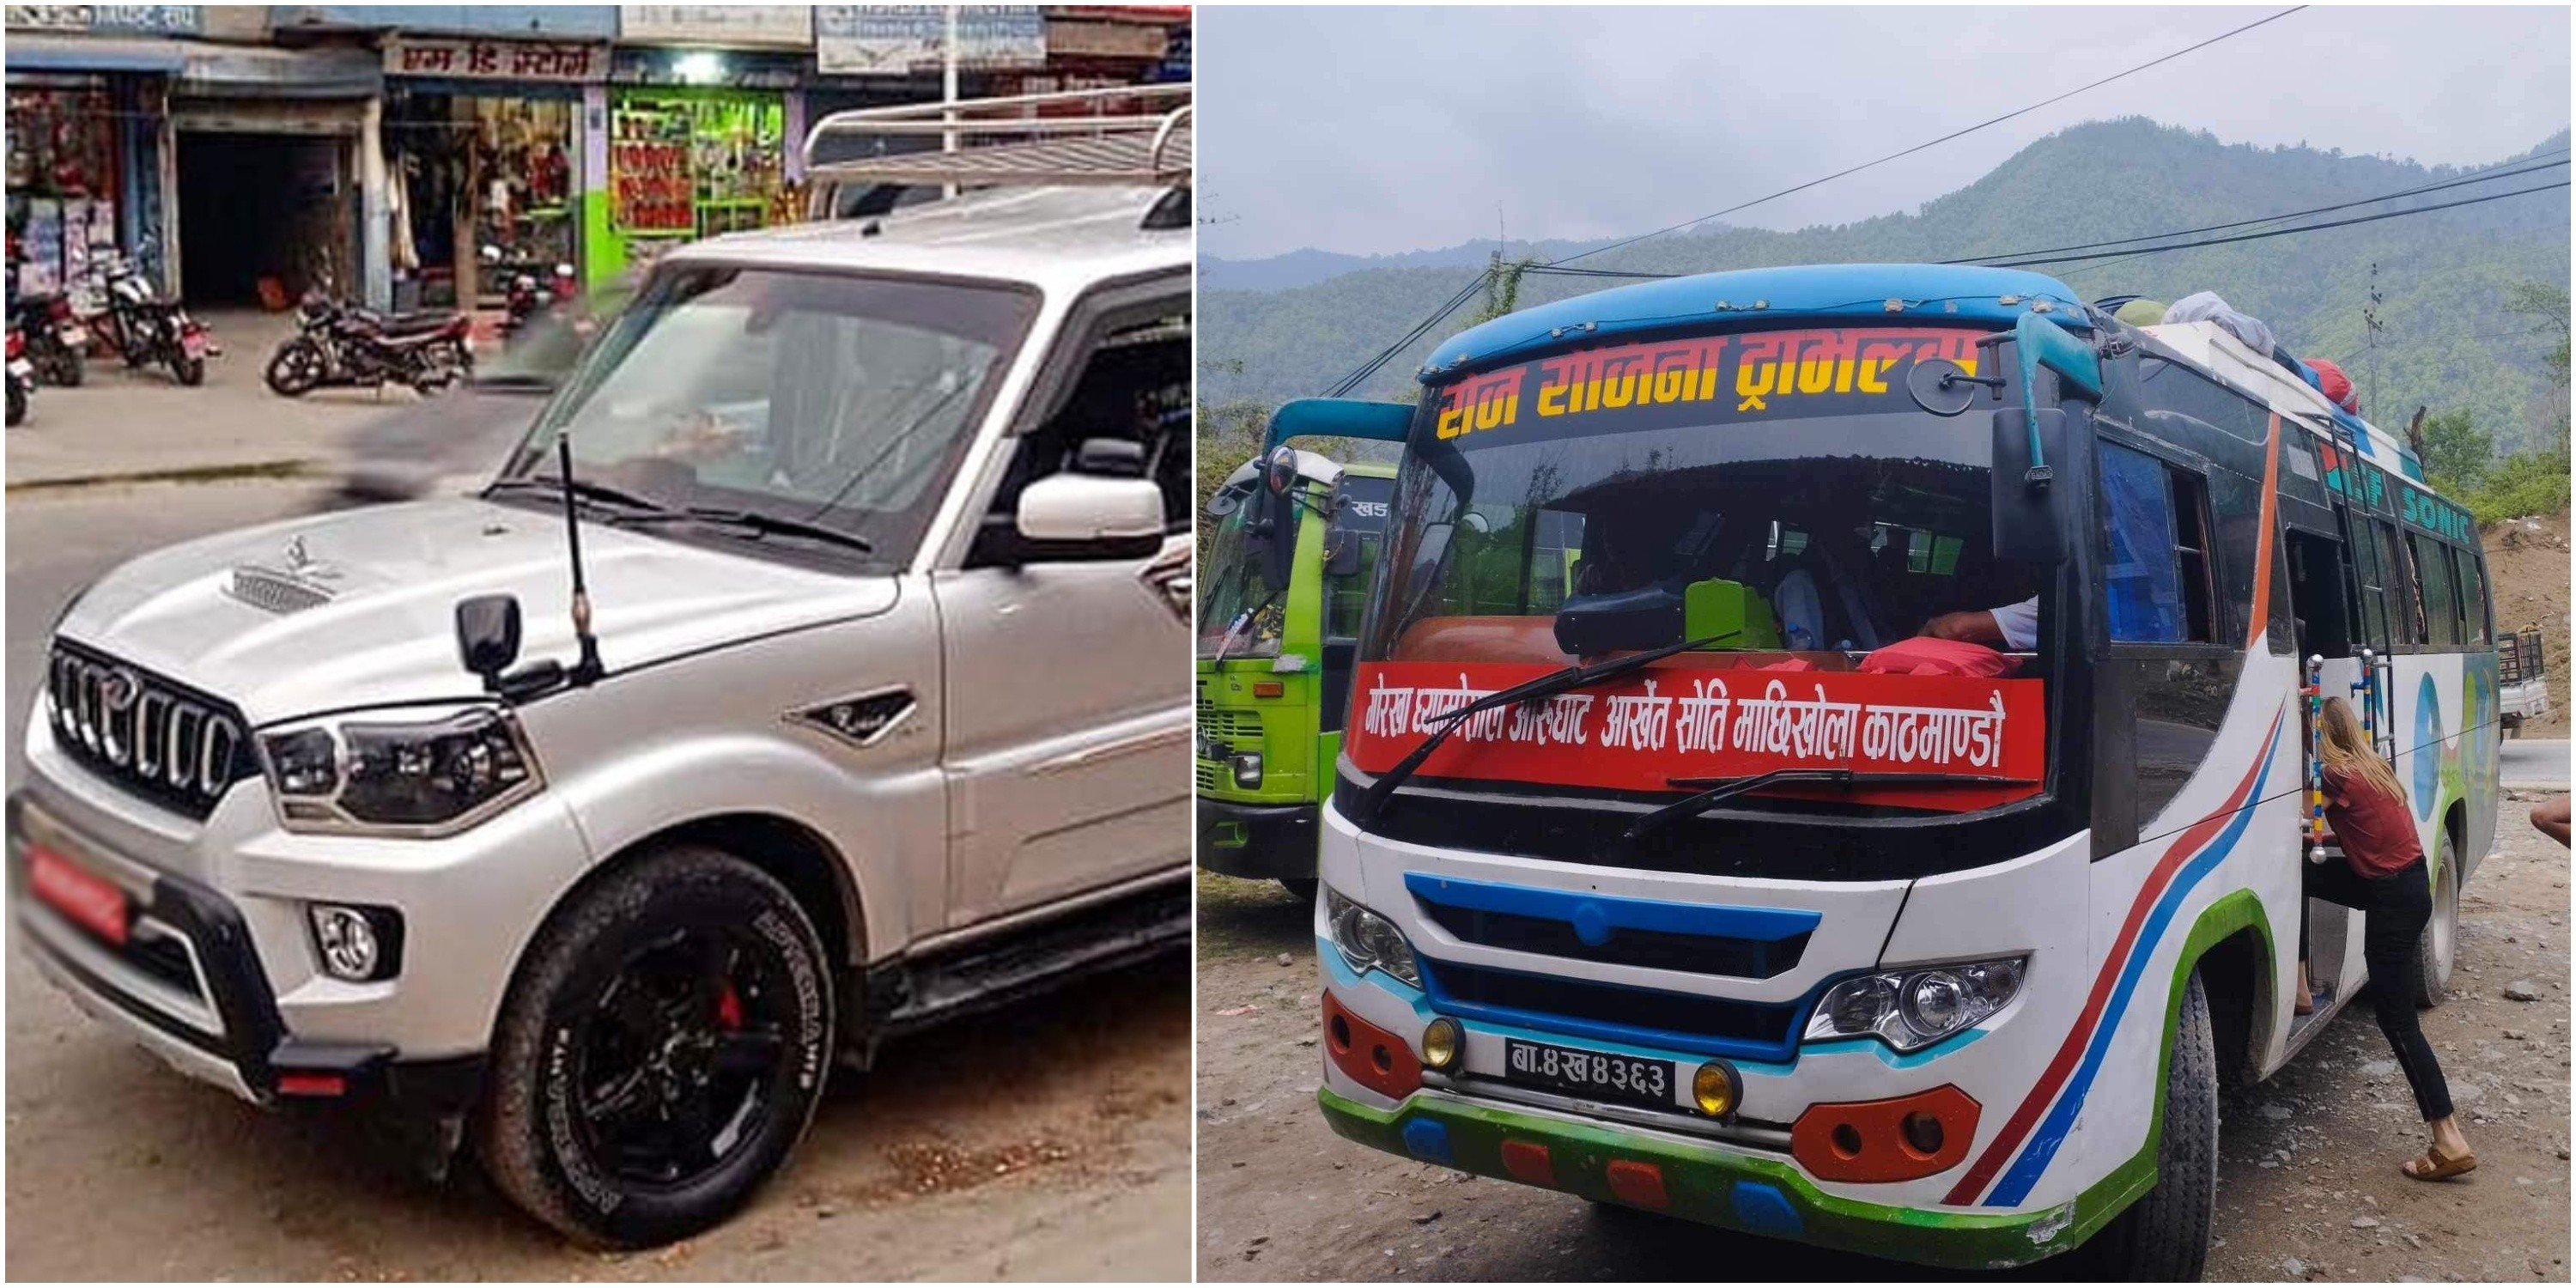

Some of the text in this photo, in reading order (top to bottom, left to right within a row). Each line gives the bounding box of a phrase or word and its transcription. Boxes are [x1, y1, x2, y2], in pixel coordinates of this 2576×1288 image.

[2401, 486, 2470, 545] SONIC
[1365, 672, 1414, 738] गोरखा
[1675, 677, 1731, 754] सोति
[1733, 678, 1862, 761] माछिखोला
[1862, 689, 2007, 769] काठमाण्डौ
